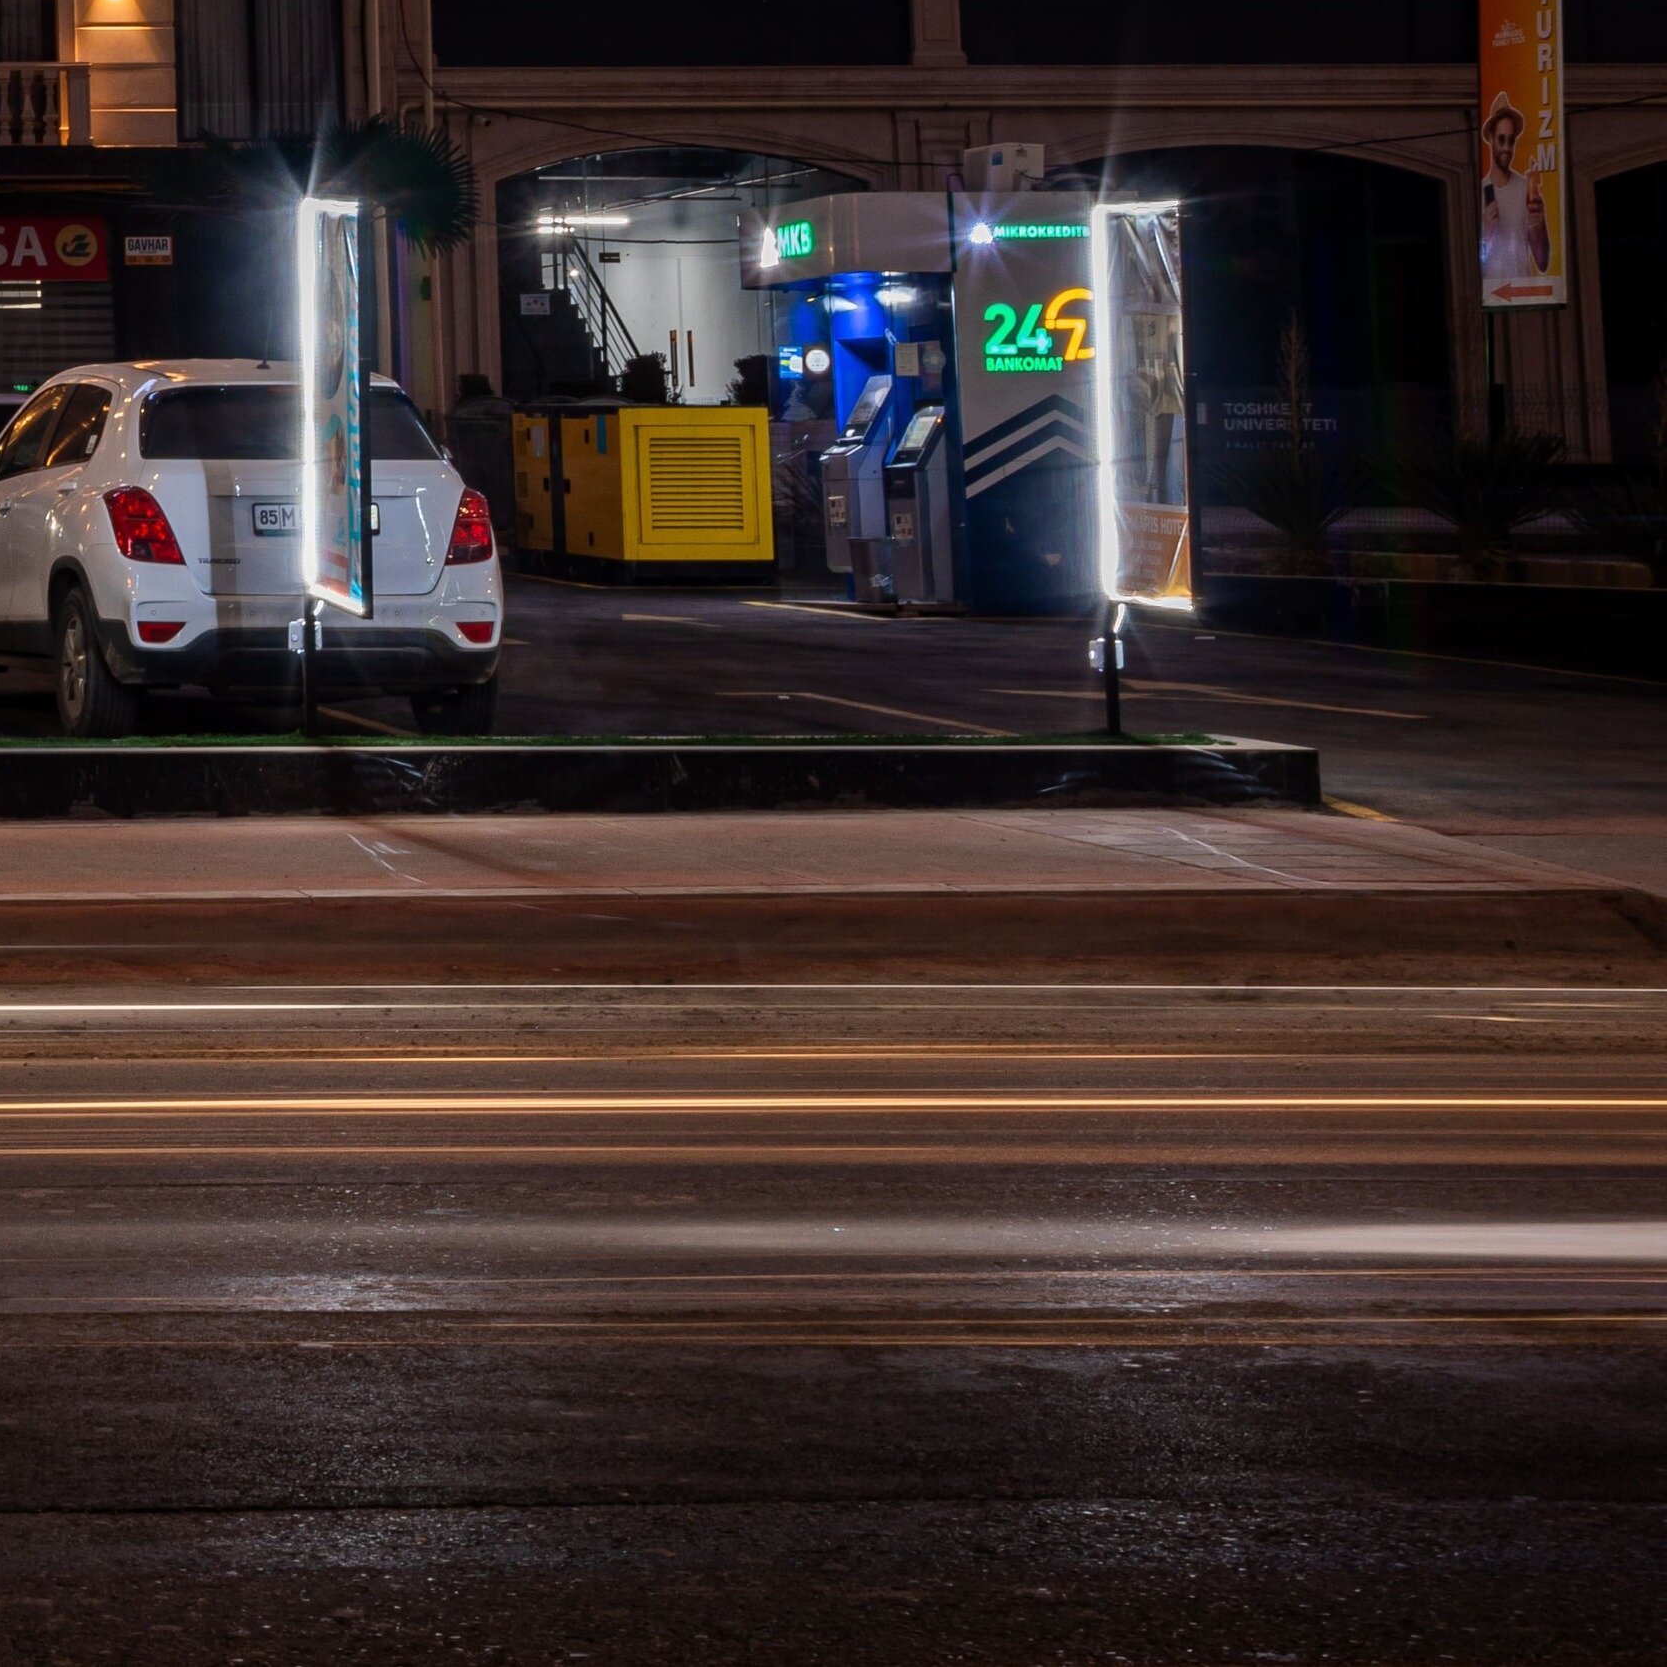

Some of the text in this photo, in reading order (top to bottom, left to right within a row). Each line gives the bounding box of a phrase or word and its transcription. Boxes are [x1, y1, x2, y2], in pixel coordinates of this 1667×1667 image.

[128, 238, 169, 251] GAVHAR
[777, 222, 813, 257] MKB
[986, 356, 1063, 372] BANKOMAT
[1223, 402, 1312, 415] TOSHKET
[1223, 418, 1337, 431] UNIVERSTETI
